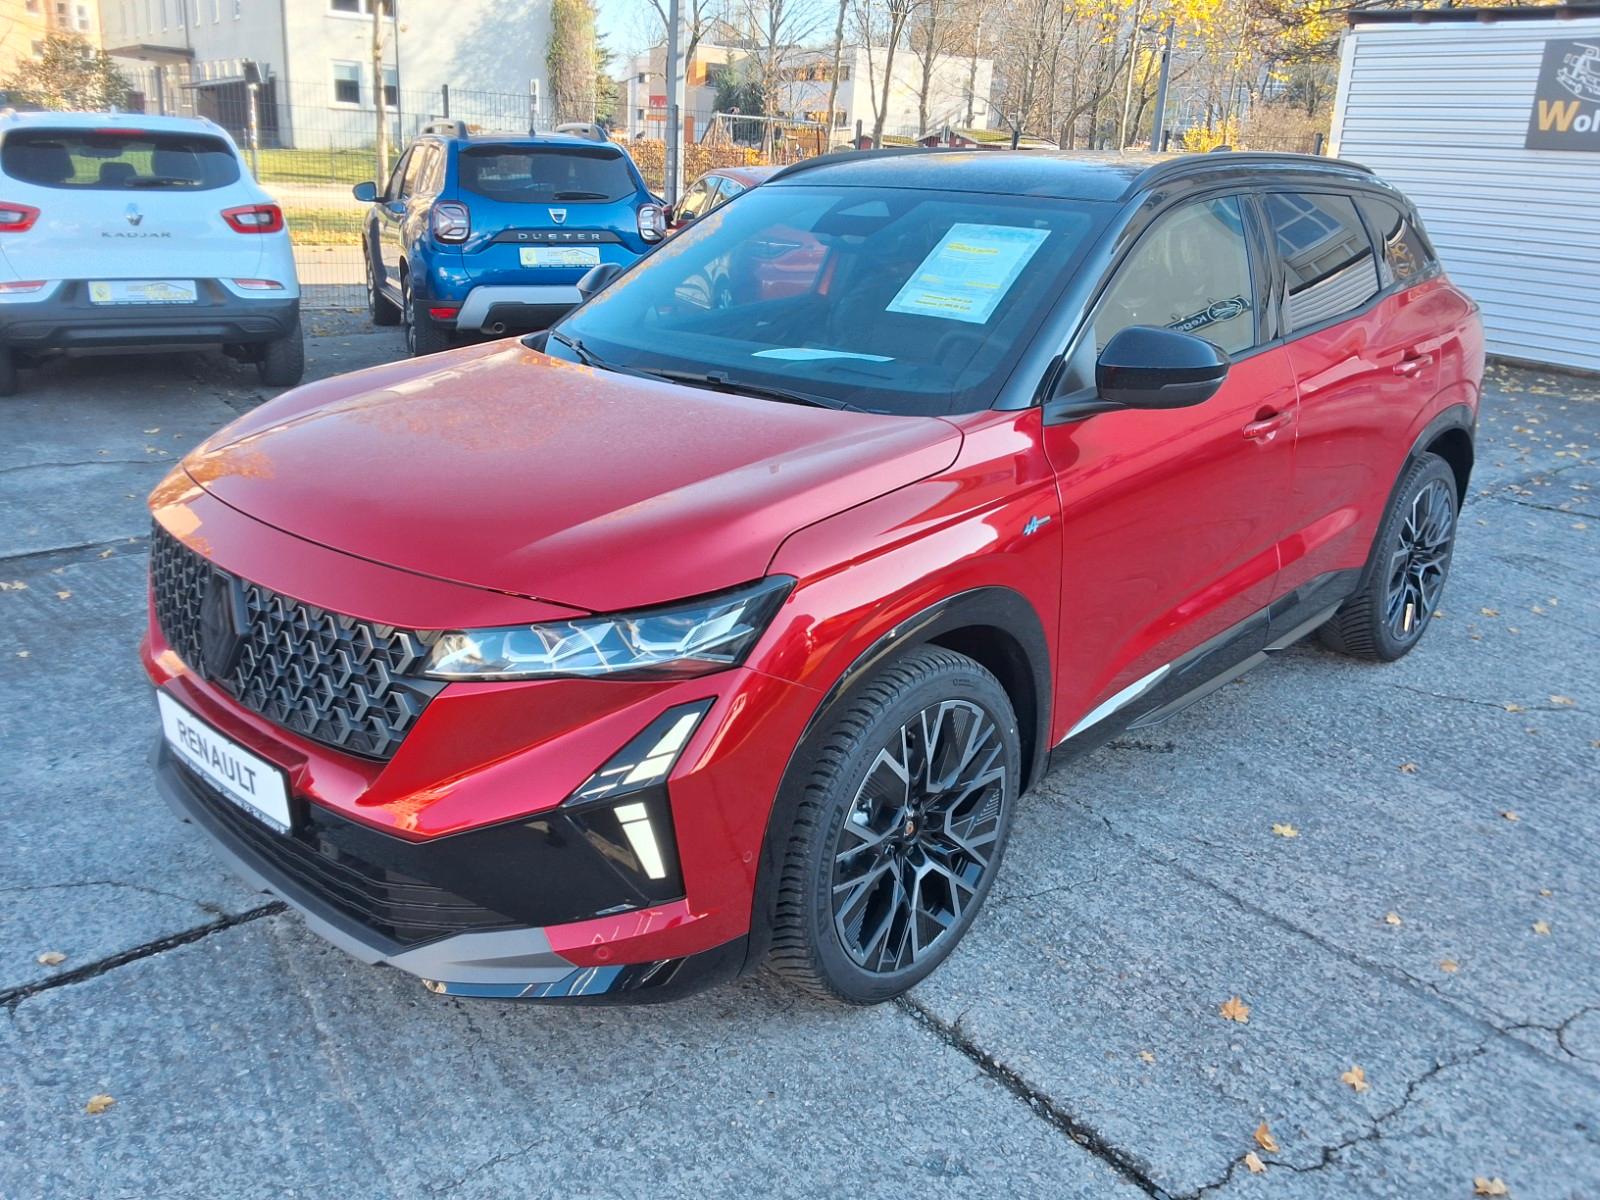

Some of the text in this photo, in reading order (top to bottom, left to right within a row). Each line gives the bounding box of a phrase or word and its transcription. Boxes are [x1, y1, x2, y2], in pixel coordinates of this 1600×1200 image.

[1537, 100, 1600, 133] Wol
[101, 231, 172, 239] KADJAR
[517, 232, 601, 240] DUSTER
[176, 717, 257, 796] RENAULT
